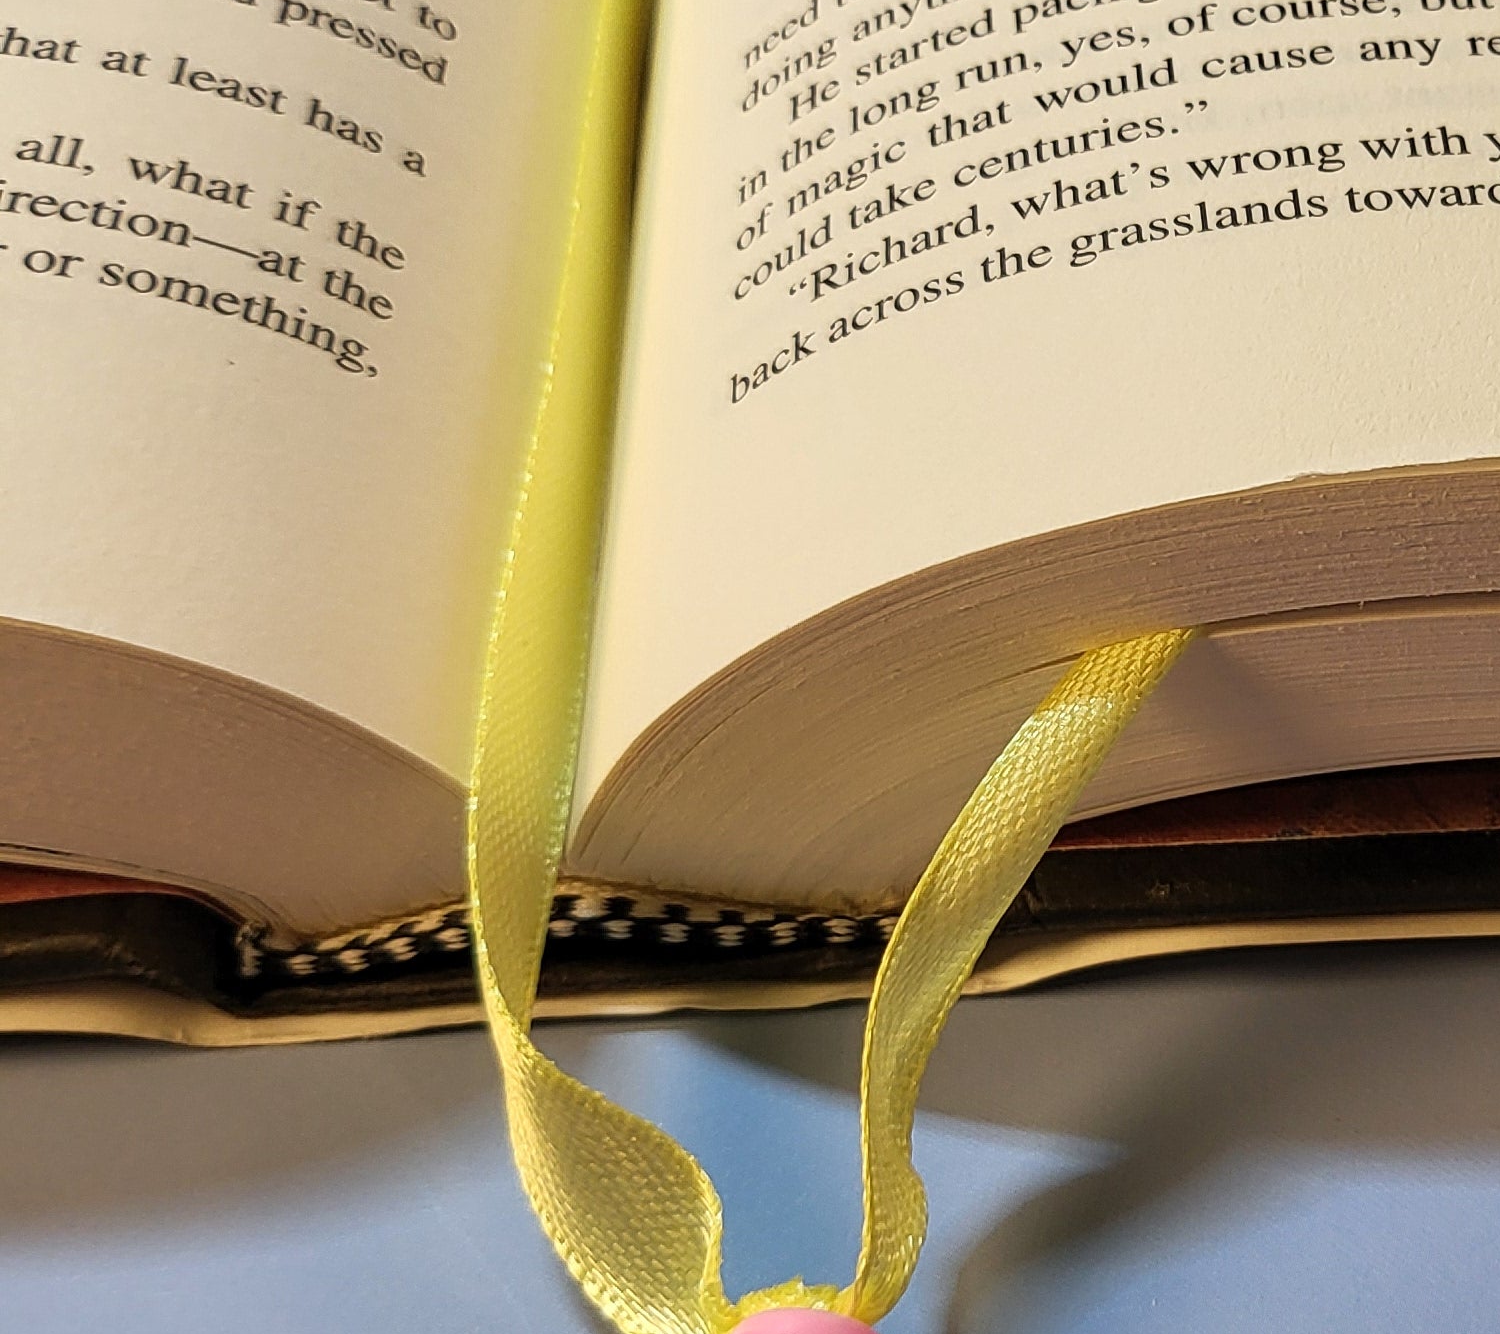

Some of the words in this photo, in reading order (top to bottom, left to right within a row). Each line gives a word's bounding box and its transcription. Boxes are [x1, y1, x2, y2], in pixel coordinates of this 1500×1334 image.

[416, 3, 458, 43] to
[740, 36, 838, 114] doing
[788, 78, 840, 123] He
[854, 6, 995, 87] started
[0, 25, 81, 66] hat
[99, 49, 151, 79] at
[168, 54, 288, 117] least
[303, 95, 384, 156] has
[401, 148, 426, 179] a
[734, 200, 774, 253] of
[786, 139, 906, 218] magic
[926, 99, 1010, 149] that
[1032, 55, 1178, 114] would
[1200, 43, 1336, 81] cause
[1358, 36, 1442, 68] any
[737, 168, 768, 206] in
[780, 126, 836, 175] the
[848, 79, 941, 136] long
[955, 50, 1044, 92] run,
[1059, 24, 1151, 70] yes,
[1166, 1, 1219, 38] of
[14, 132, 95, 178] all,
[127, 155, 255, 211] what
[272, 189, 323, 232] if
[335, 218, 406, 272] the
[732, 212, 833, 302] could
[847, 177, 936, 232] take
[952, 97, 1209, 189] centuries.”
[788, 202, 996, 303] “Richard,
[1009, 160, 1171, 222] what’s
[1185, 140, 1347, 182] wrong
[1358, 123, 1472, 162] with
[21, 248, 86, 280] or
[97, 261, 379, 380] something,
[322, 268, 394, 322] the
[729, 329, 817, 406] back
[827, 269, 966, 346] across
[979, 243, 1054, 285] the
[1068, 186, 1330, 270] grasslands
